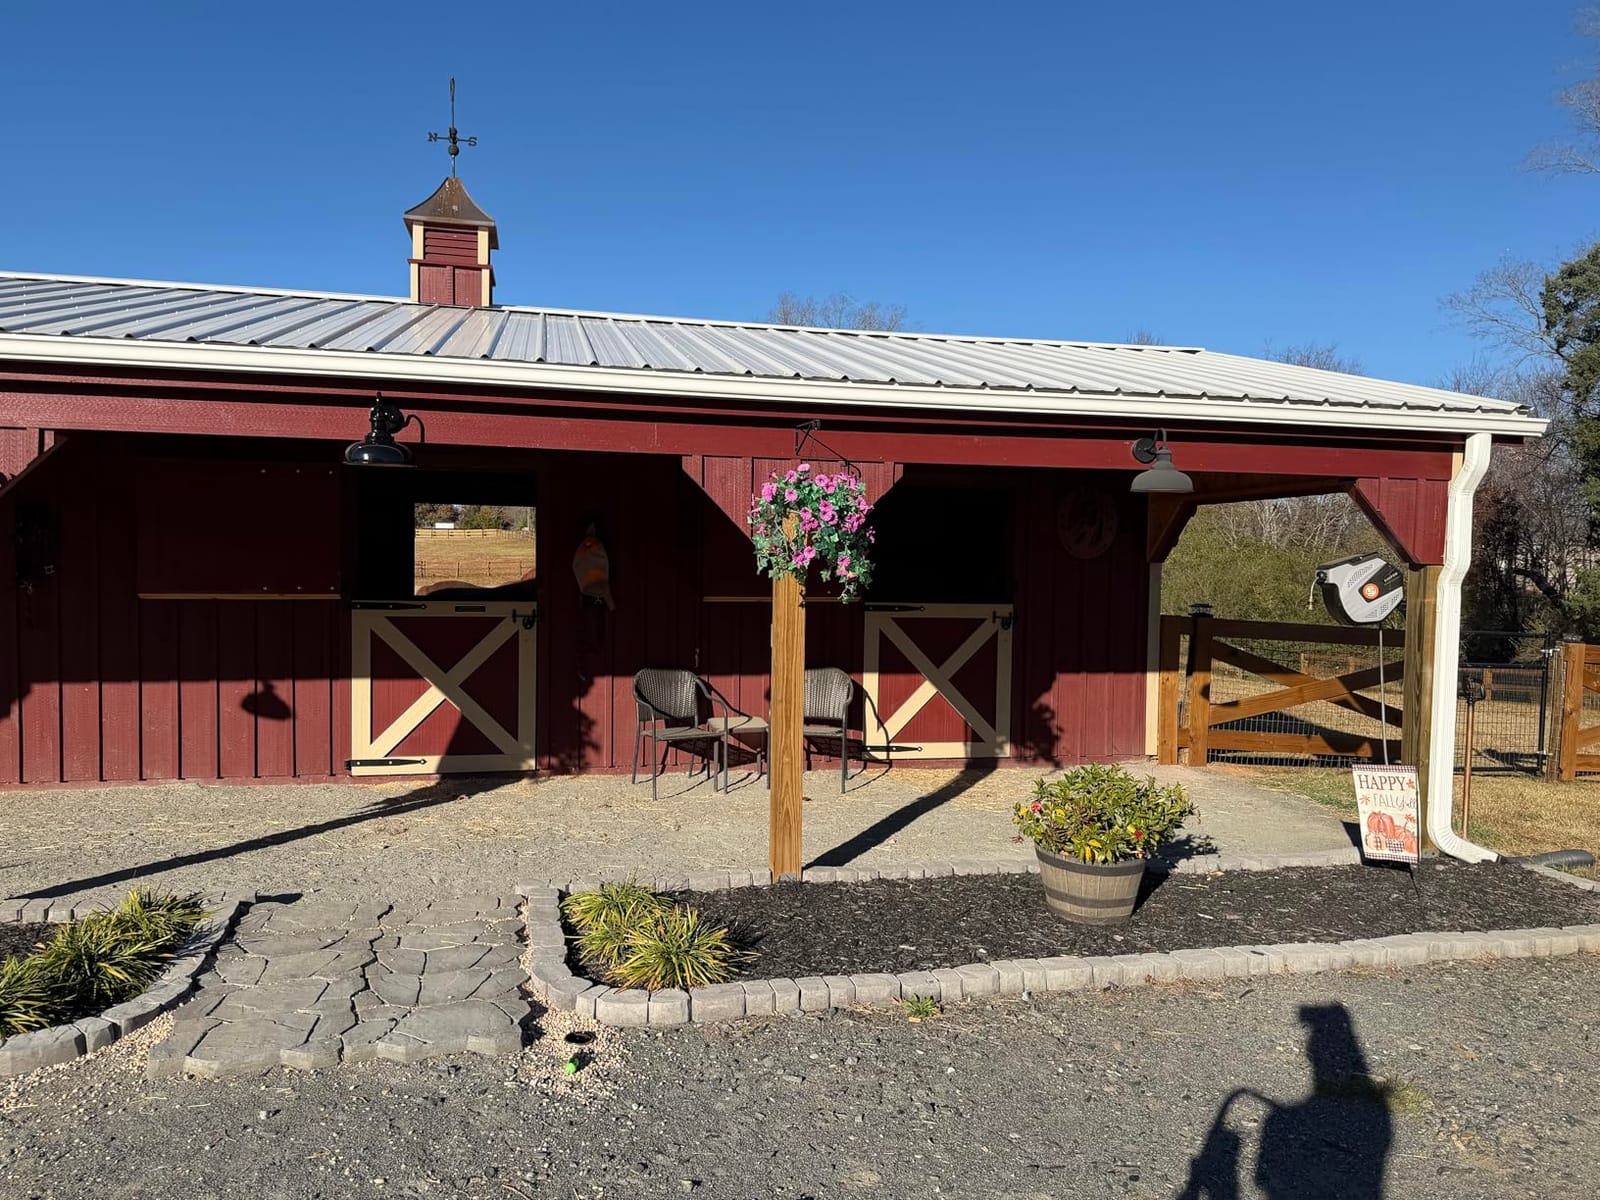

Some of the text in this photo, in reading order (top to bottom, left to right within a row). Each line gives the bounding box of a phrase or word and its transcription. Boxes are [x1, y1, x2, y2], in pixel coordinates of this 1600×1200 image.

[427, 131, 438, 142] N
[468, 136, 477, 146] S
[1357, 774, 1406, 791] HAPPY
